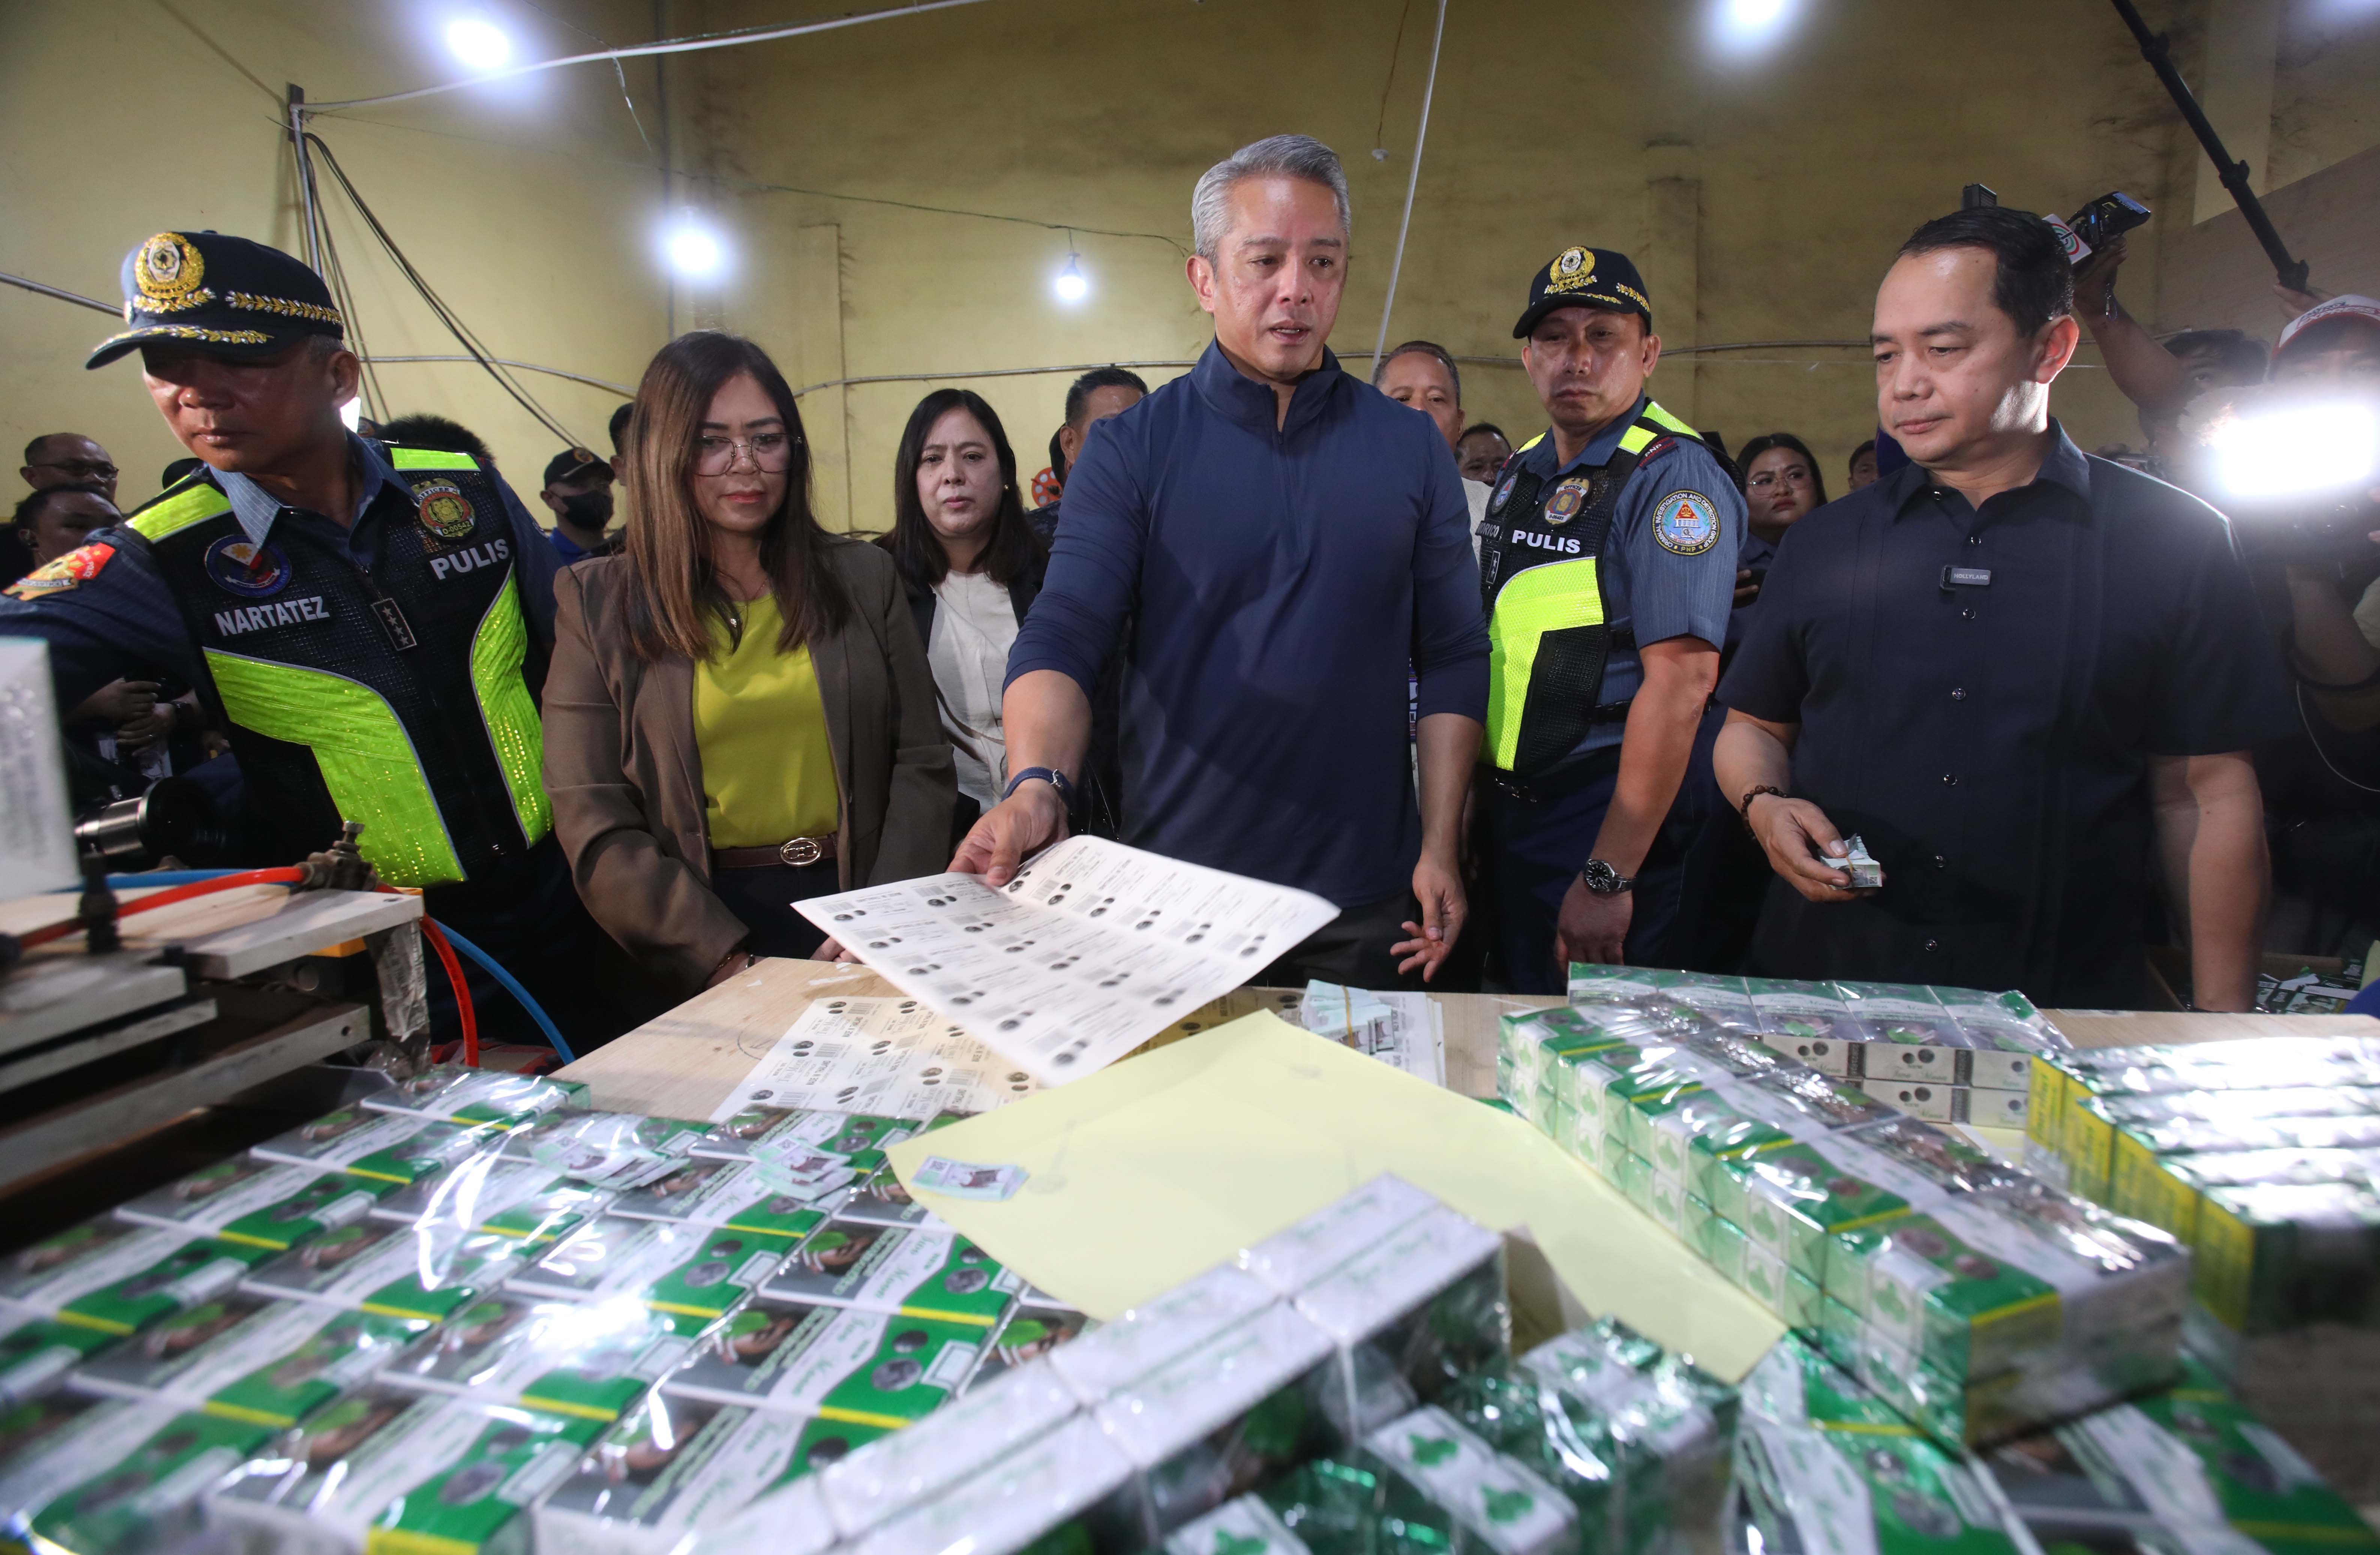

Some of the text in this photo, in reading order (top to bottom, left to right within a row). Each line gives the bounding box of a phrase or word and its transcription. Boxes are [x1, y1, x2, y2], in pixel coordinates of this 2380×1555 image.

[1645, 444, 1662, 457] PNP
[419, 487, 449, 501] OFFICER
[1655, 493, 1717, 548] CRIMINAL INVESTIGATION AND DETECTION GROUP
[1512, 530, 1581, 554] PULIS
[429, 539, 509, 580] PULIS
[215, 596, 330, 636] NARTATEZ
